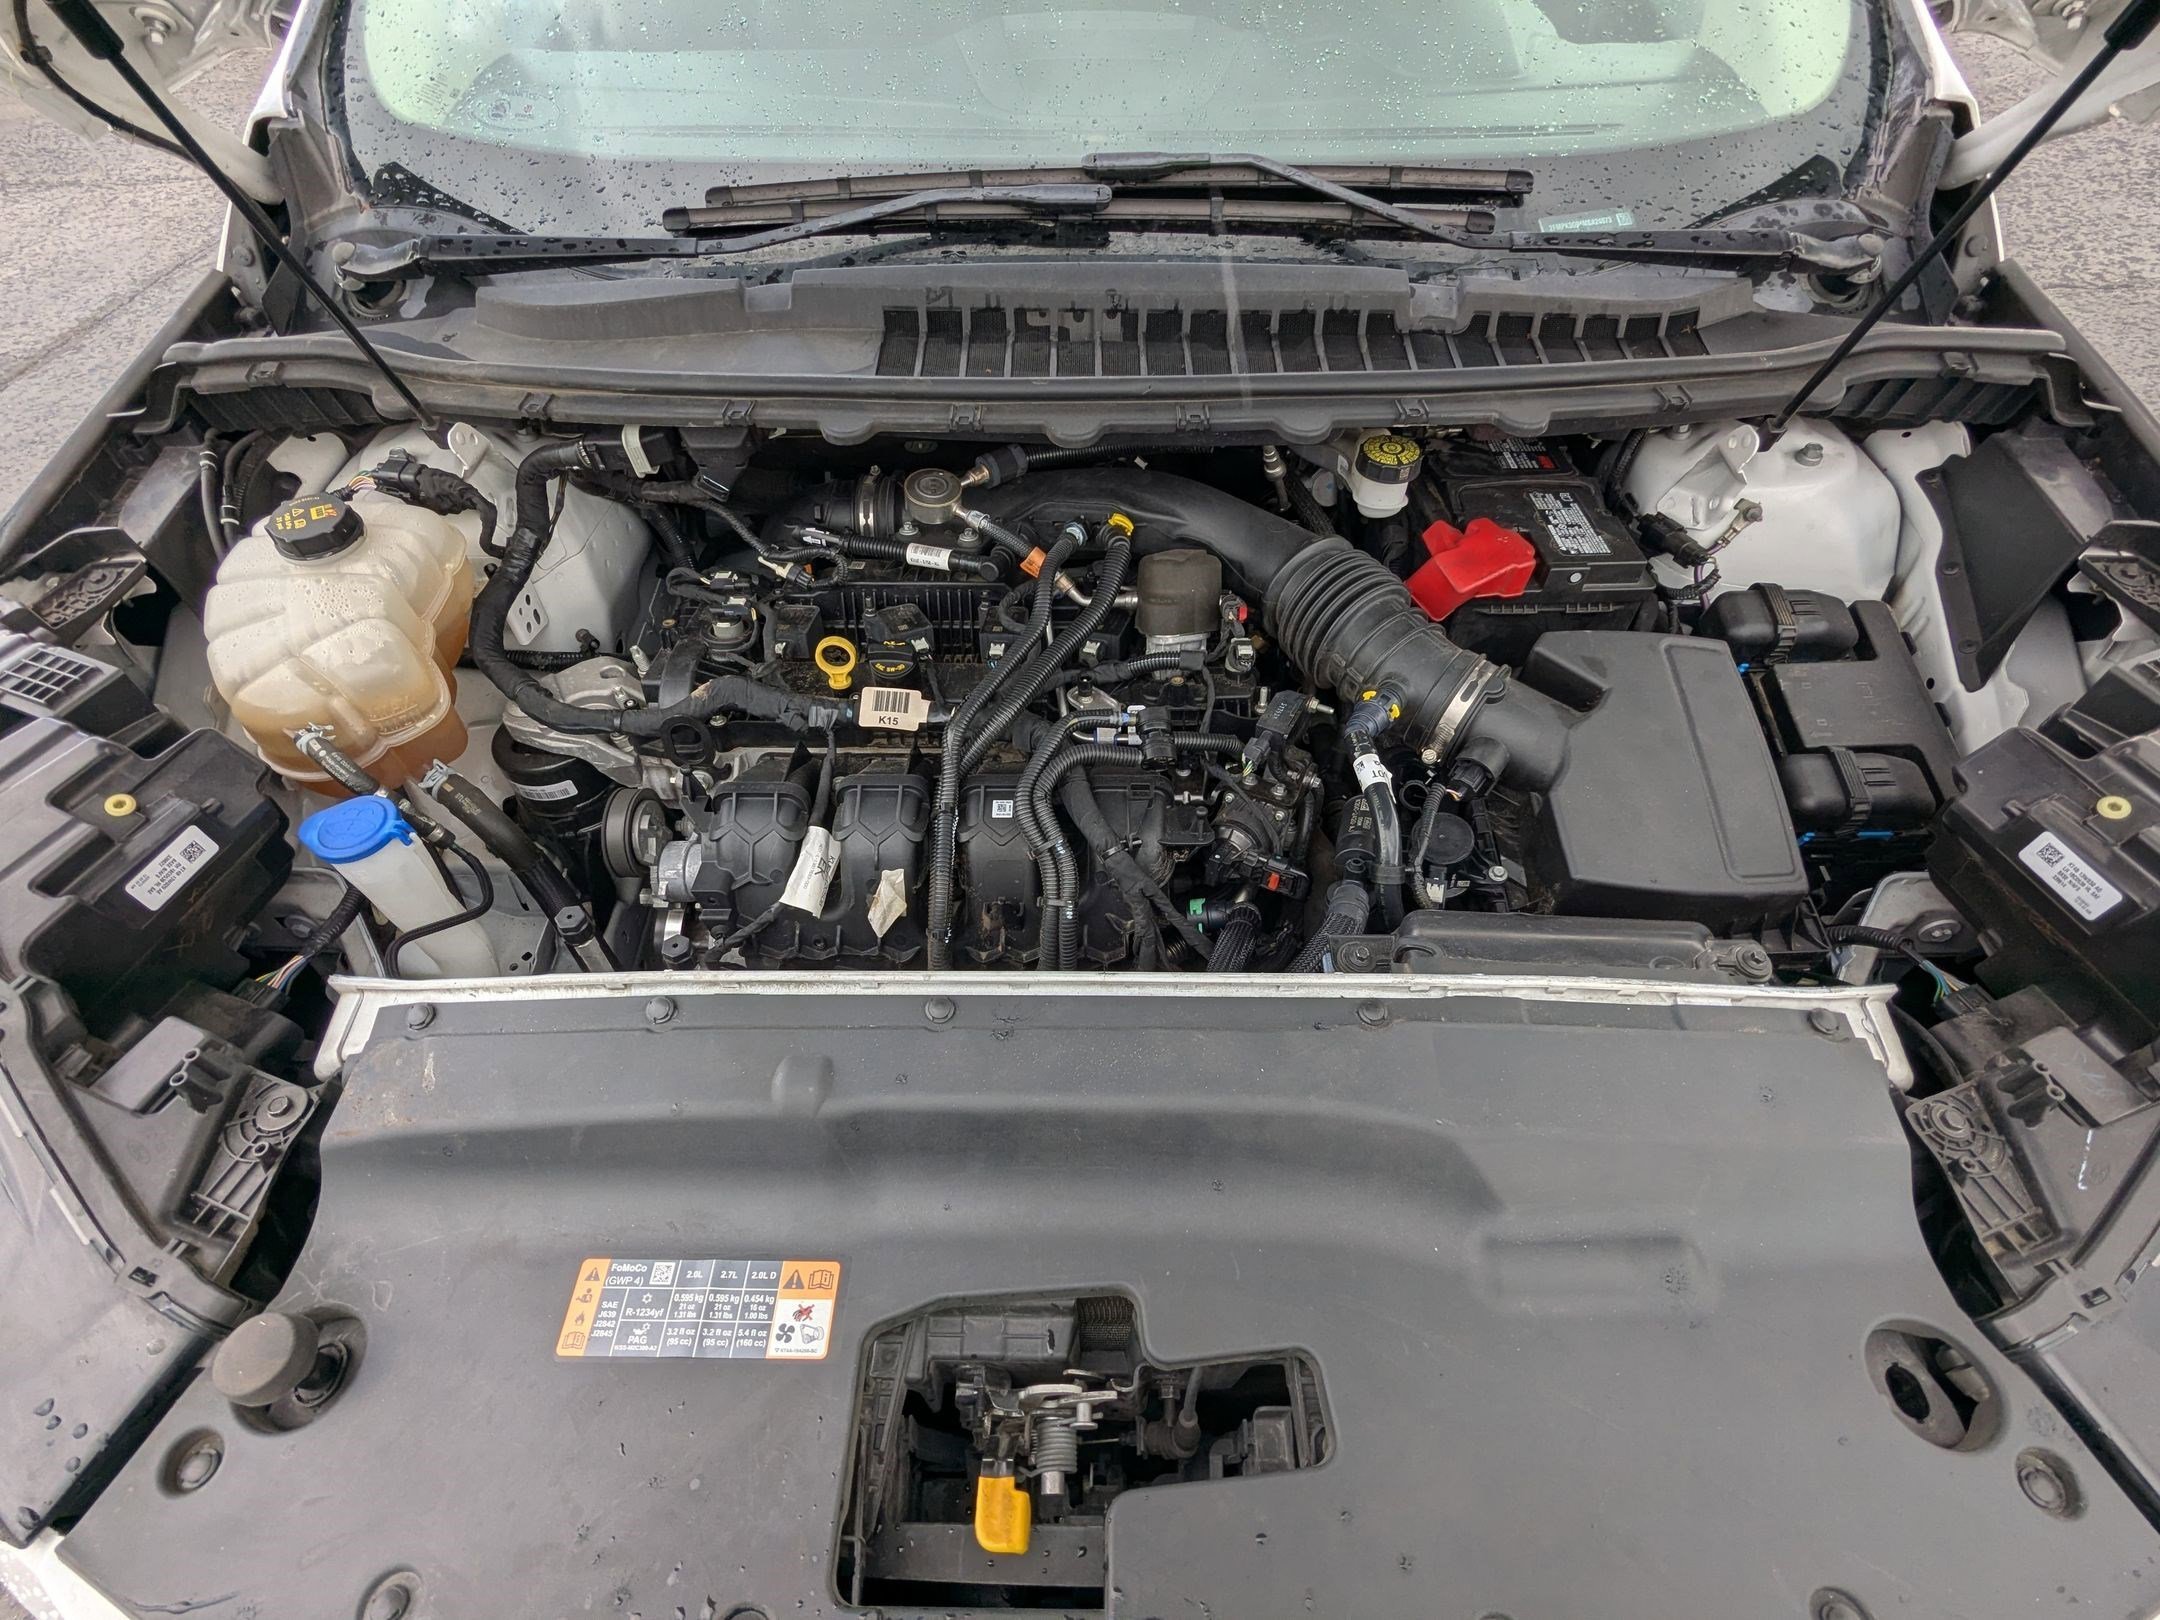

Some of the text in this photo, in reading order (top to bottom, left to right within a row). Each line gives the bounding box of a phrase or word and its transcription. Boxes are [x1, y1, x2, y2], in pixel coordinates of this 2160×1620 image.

[878, 715, 898, 725] K15
[611, 1263, 648, 1273] FoMoCo
[686, 1270, 703, 1279] 2.0L
[720, 1270, 738, 1279] 2.7L
[751, 1271, 777, 1279] 2.0L D
[604, 1276, 644, 1287] (GWP 4)
[674, 1294, 704, 1304] 0.595 kg
[708, 1294, 739, 1305] 0.595 kg
[743, 1295, 775, 1305] 0.454 kg
[601, 1301, 619, 1309] SAE
[625, 1308, 664, 1319] R-1234yf
[723, 1311, 733, 1319] lbs
[666, 1328, 678, 1336] 3.2
[702, 1328, 714, 1336] 3.2
[627, 1336, 648, 1344] PAG
[666, 1337, 692, 1346] (95 cc)
[702, 1338, 729, 1347] (95 cc)
[735, 1338, 766, 1347] (160 cc)
